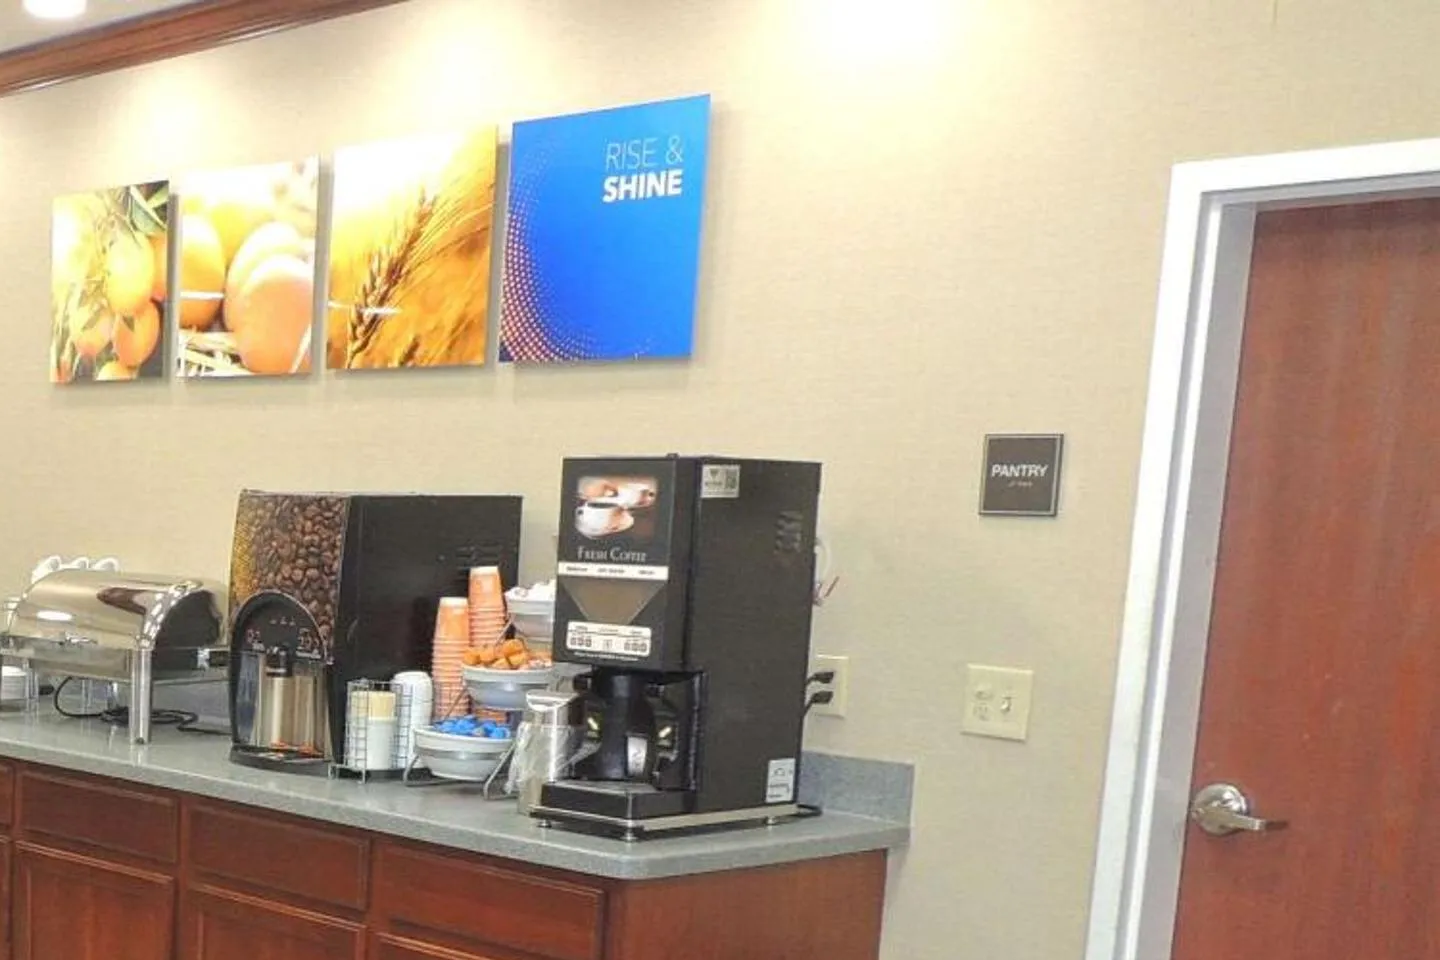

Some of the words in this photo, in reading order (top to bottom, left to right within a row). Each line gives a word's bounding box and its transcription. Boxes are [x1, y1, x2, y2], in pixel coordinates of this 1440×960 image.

[605, 137, 659, 171] RISE
[665, 134, 684, 165] &
[602, 168, 684, 203] SHINE
[991, 463, 1049, 478] PANTRY
